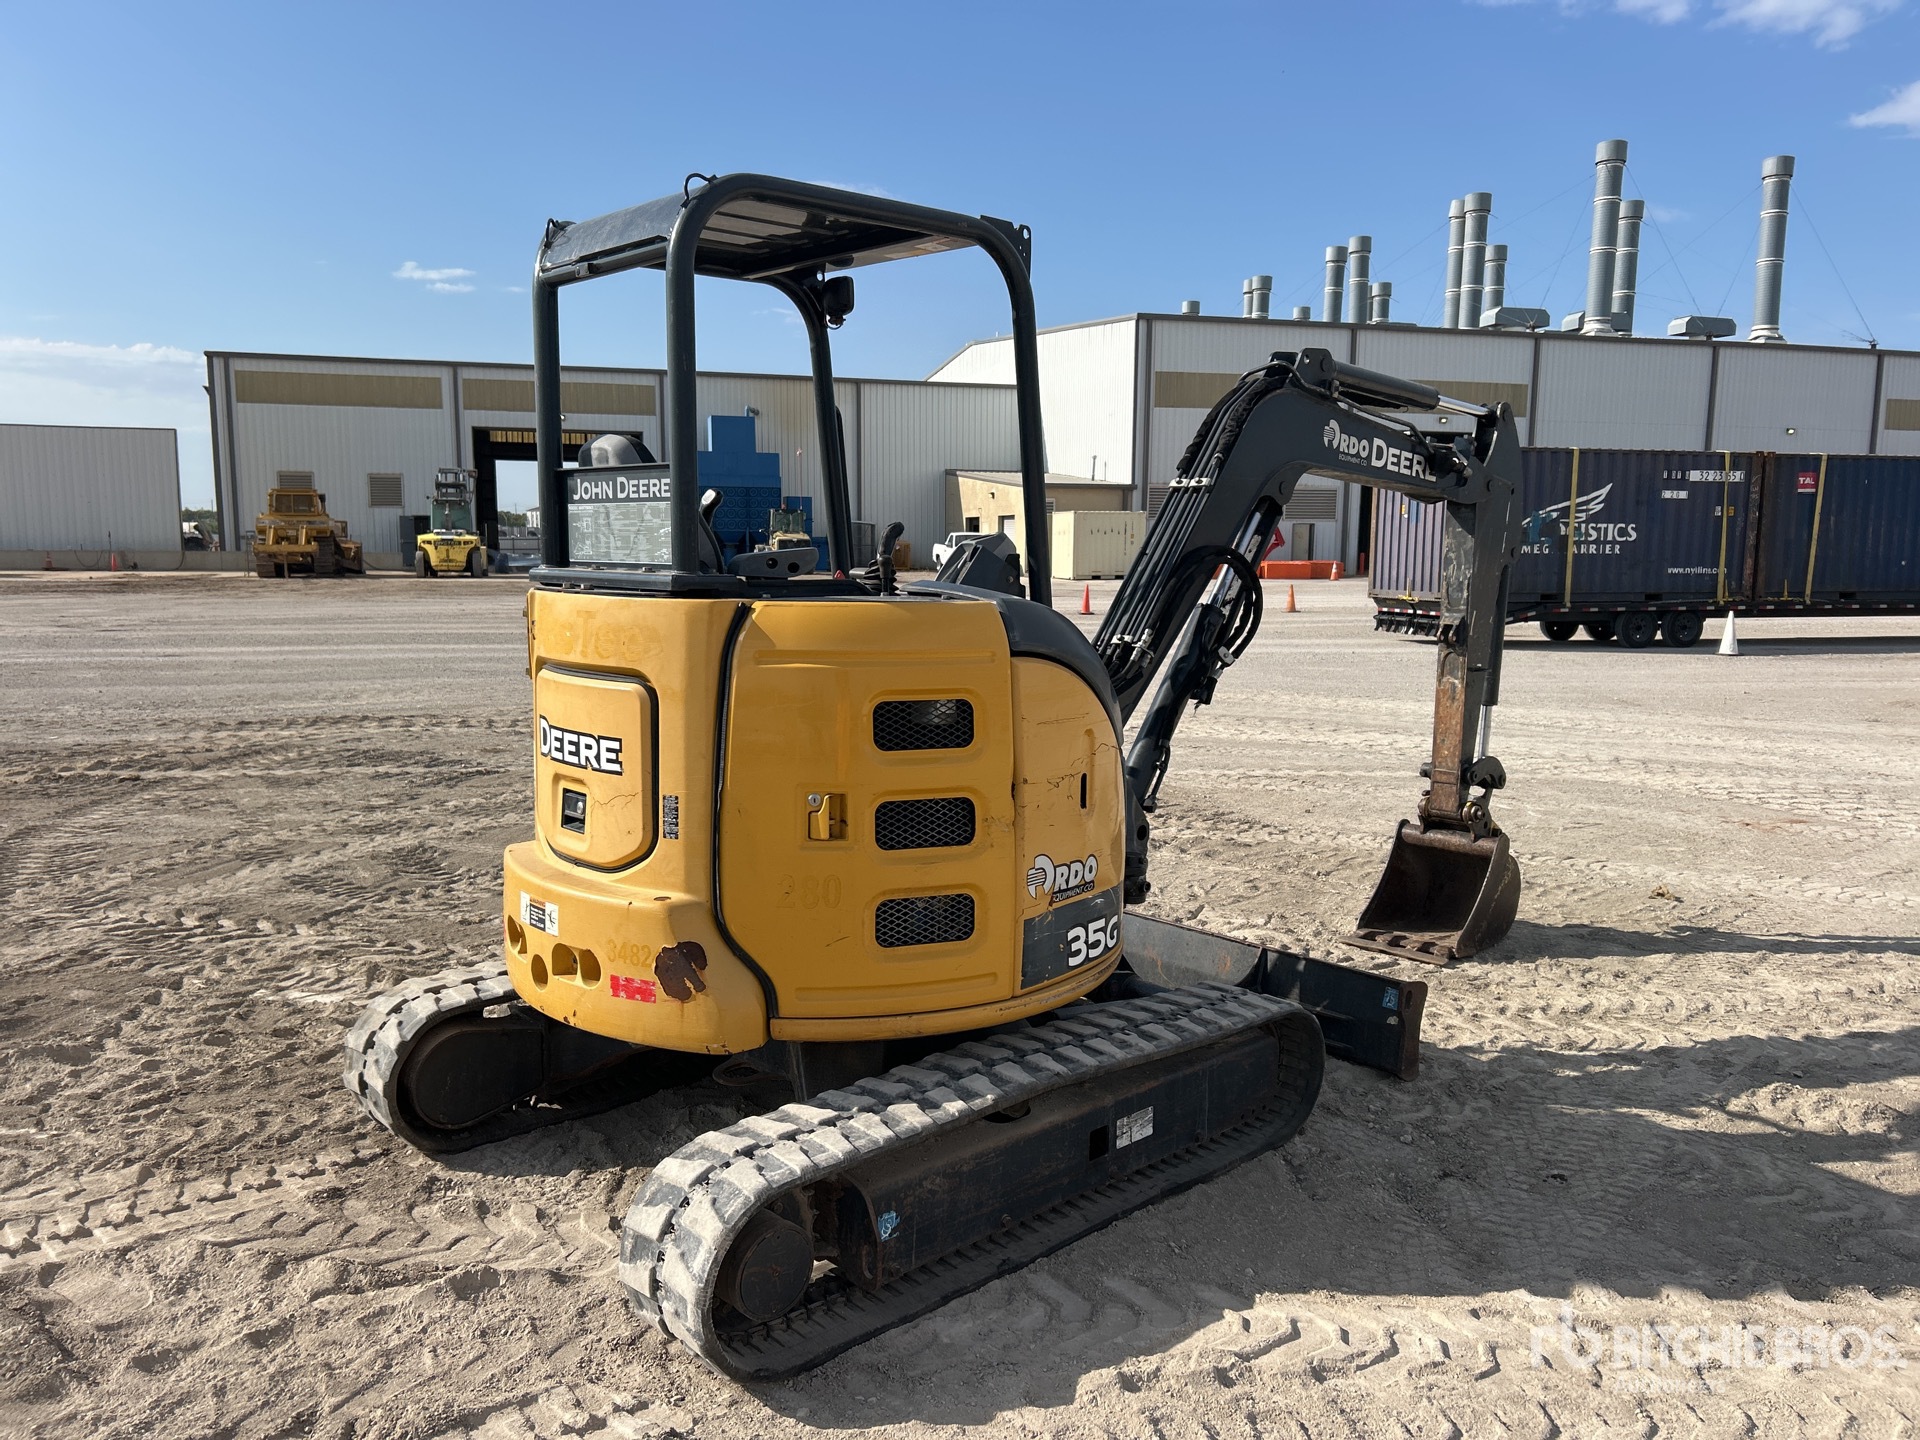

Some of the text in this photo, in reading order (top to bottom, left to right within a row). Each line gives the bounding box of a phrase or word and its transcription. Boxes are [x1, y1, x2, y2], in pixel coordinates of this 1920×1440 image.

[572, 476, 671, 501] JOHN DEERE
[1520, 544, 1621, 554] MEG ARRIER
[540, 715, 623, 775] DEERE
[1067, 915, 1119, 967] 35G
